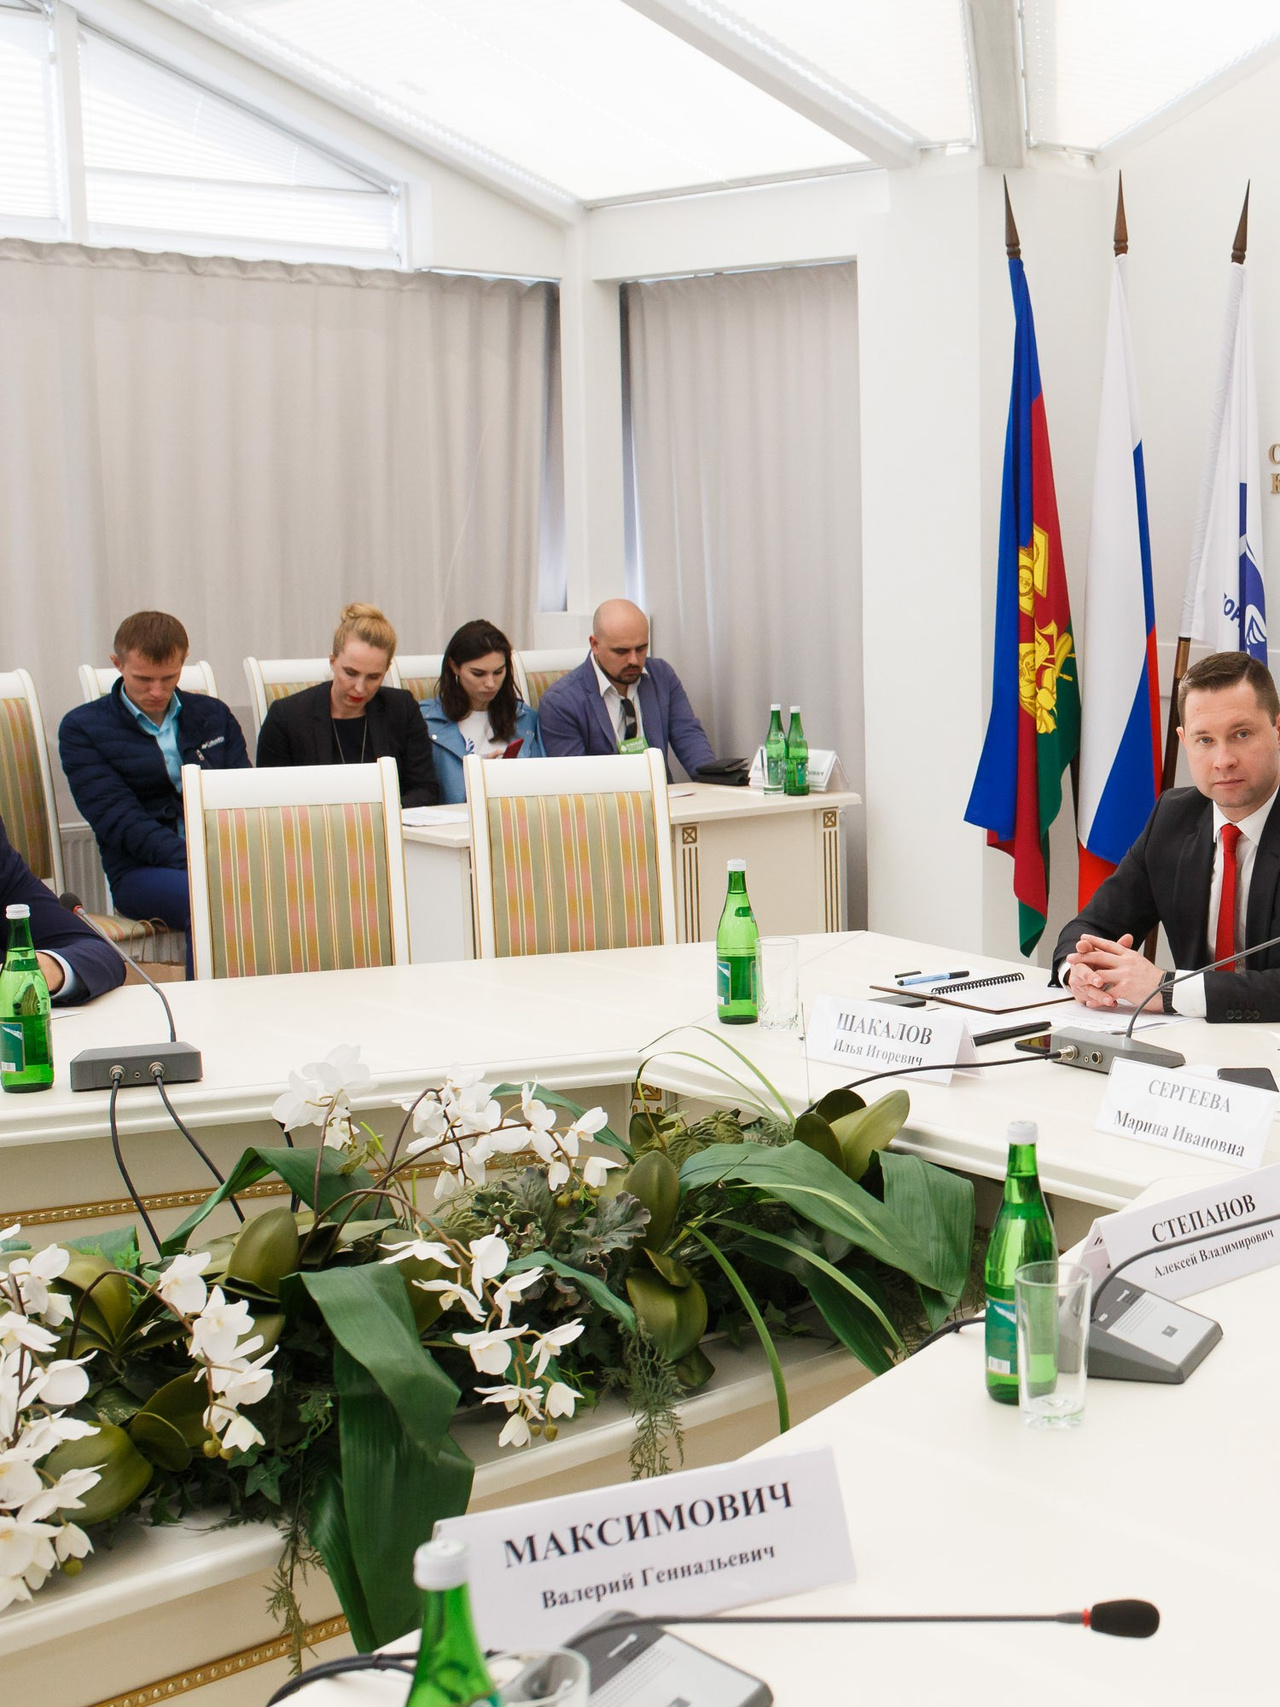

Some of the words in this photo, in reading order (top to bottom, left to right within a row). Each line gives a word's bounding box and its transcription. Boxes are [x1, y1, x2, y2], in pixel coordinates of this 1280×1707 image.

[837, 1012, 933, 1045] ШАКАЛОВ
[833, 1038, 863, 1055] Илья
[866, 1044, 923, 1066] Игоревич
[1148, 1079, 1231, 1113] СЕРГЕЕВА
[1113, 1110, 1169, 1137] Марина
[1172, 1124, 1246, 1157] Ивановна
[1152, 1194, 1256, 1243] СТЕПАНОВ
[1154, 1252, 1199, 1279] Алексей
[1199, 1229, 1275, 1262] Владимирович
[502, 1481, 795, 1569] МАКСИМОВИЧ
[541, 1571, 636, 1610] Валерий
